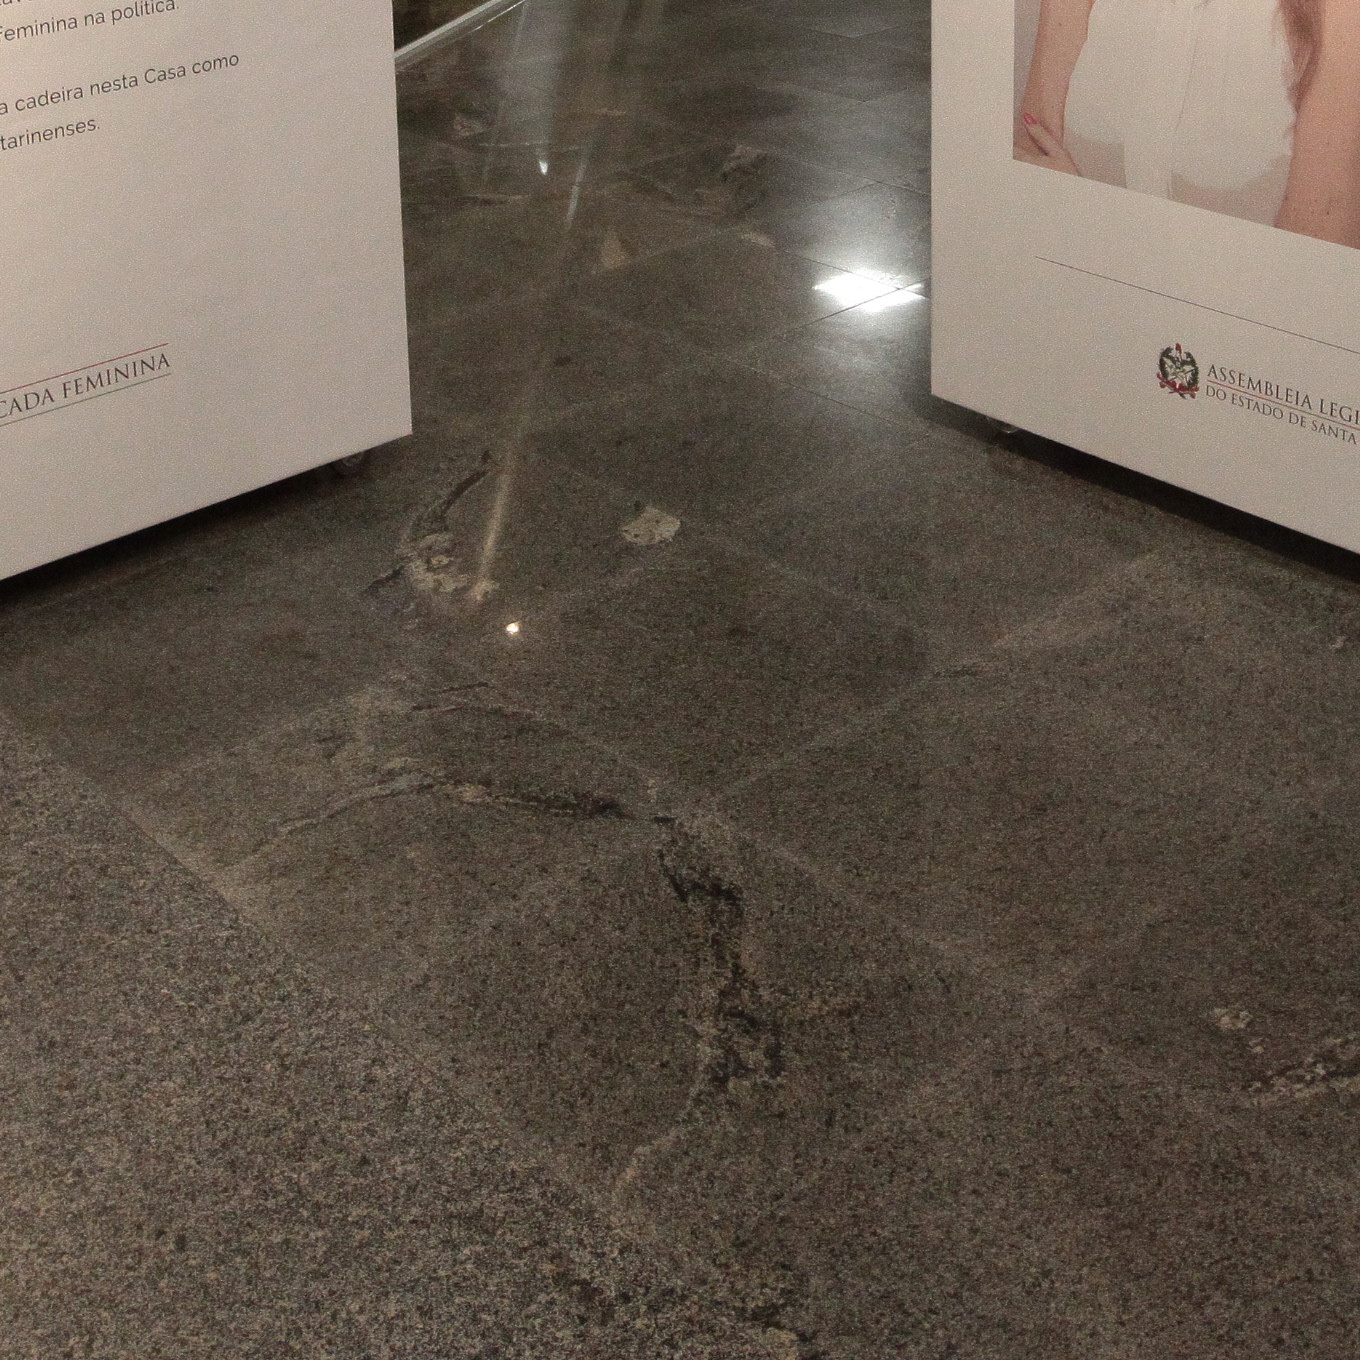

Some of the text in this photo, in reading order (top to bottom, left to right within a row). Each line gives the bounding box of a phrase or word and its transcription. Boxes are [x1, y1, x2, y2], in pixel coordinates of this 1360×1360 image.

[14, 86, 83, 111] cadeira
[89, 74, 138, 95] nesta
[143, 65, 186, 84] Casa
[191, 54, 239, 74] como
[62, 352, 170, 398] FEMININA
[1207, 364, 1312, 410] ASSEMBLEIA
[1205, 384, 1227, 400] DO
[1231, 392, 1283, 419] ESTADO
[1288, 411, 1305, 427] DE
[1311, 420, 1356, 444] SANTA
